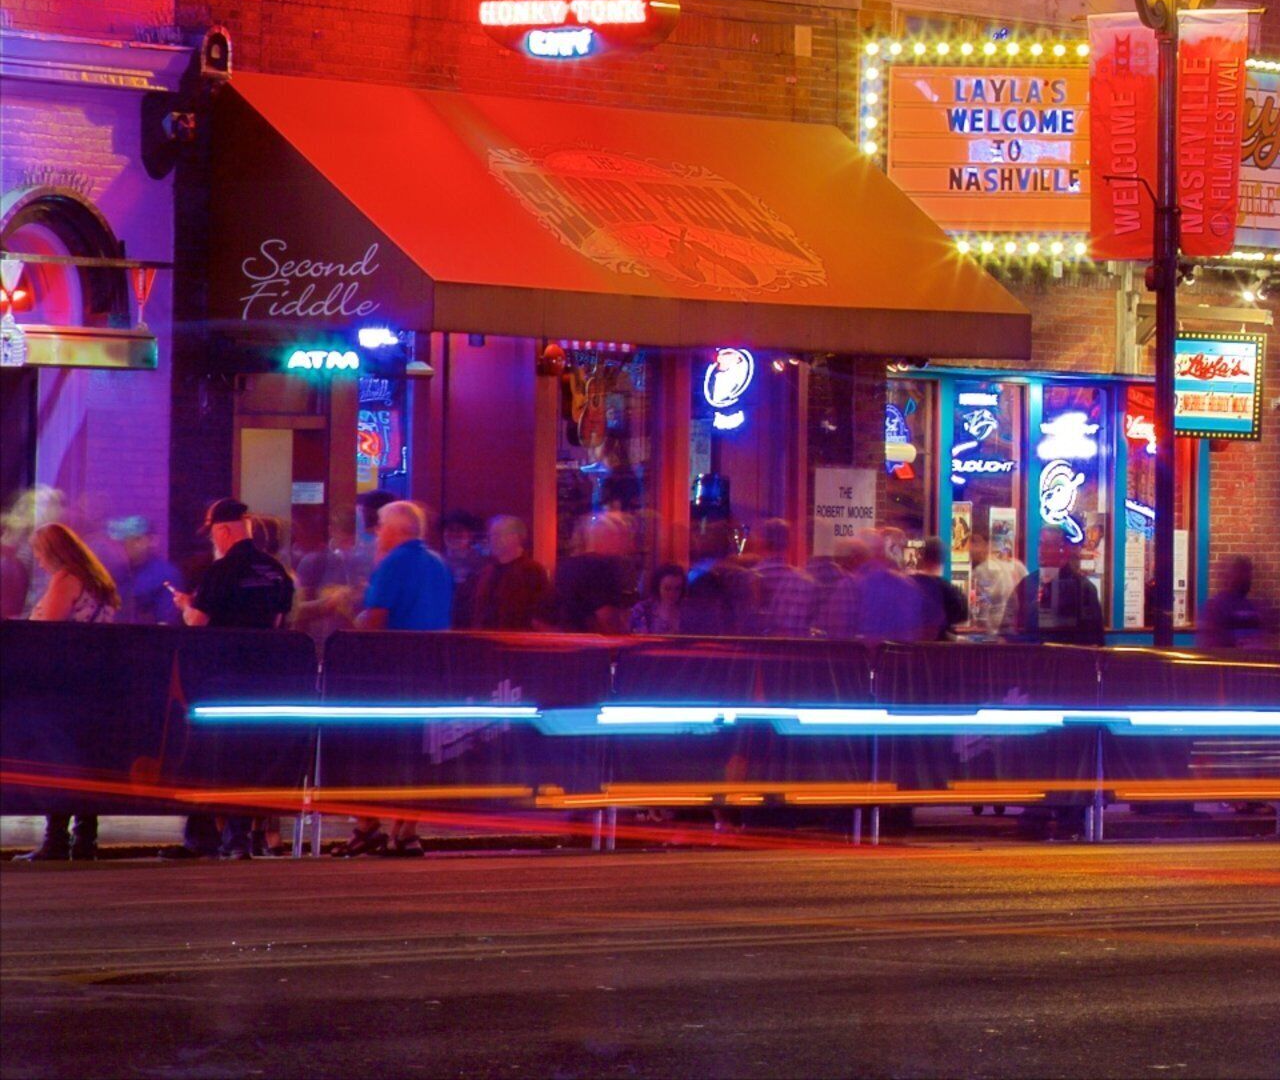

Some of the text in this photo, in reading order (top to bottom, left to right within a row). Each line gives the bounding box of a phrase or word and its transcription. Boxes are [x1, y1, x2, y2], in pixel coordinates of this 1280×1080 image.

[479, 0, 569, 25] HONKY
[955, 79, 1066, 104] LAYLA'S
[947, 108, 1075, 134] WELCOME
[1212, 58, 1240, 201] FILM FESTIVAL
[1181, 57, 1211, 234] NASHVILLE
[949, 167, 1080, 192] NASHVILLE
[242, 239, 380, 280] Second
[240, 278, 380, 320] Fiddle
[288, 351, 360, 369] ATM
[838, 486, 854, 500] THE
[816, 505, 874, 519] ROBERT MOORE
